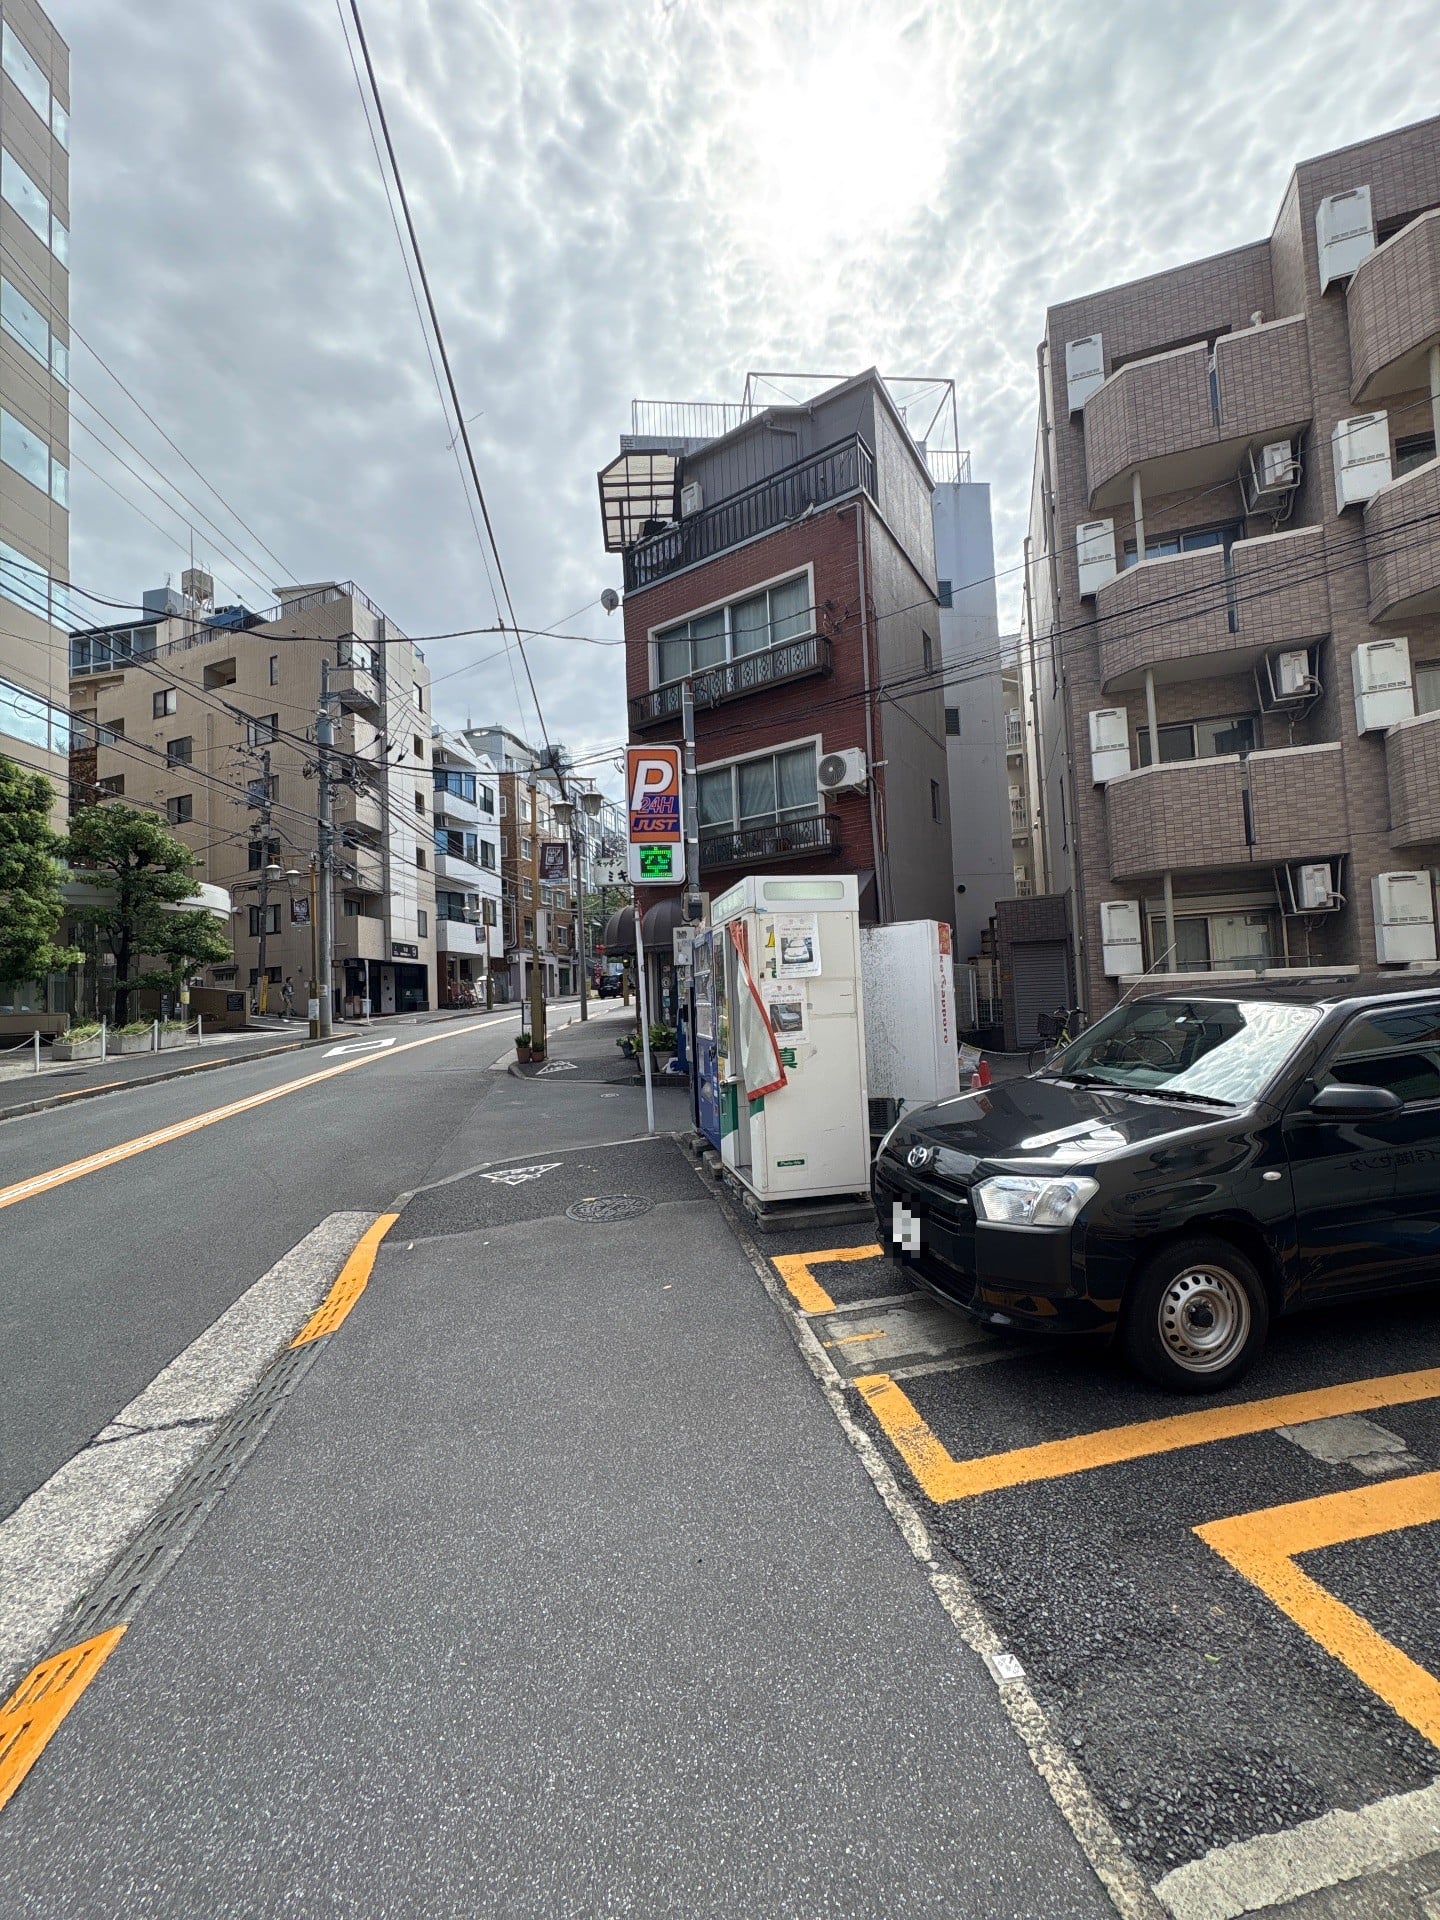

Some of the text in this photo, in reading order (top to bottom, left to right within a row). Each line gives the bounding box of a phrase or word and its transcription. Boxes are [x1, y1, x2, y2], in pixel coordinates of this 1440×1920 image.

[631, 759, 674, 811] P
[639, 796, 674, 814] 24H
[633, 818, 678, 832] JUST
[596, 858, 623, 868] キッチン
[640, 846, 672, 878] 空
[608, 869, 629, 883] ミキ
